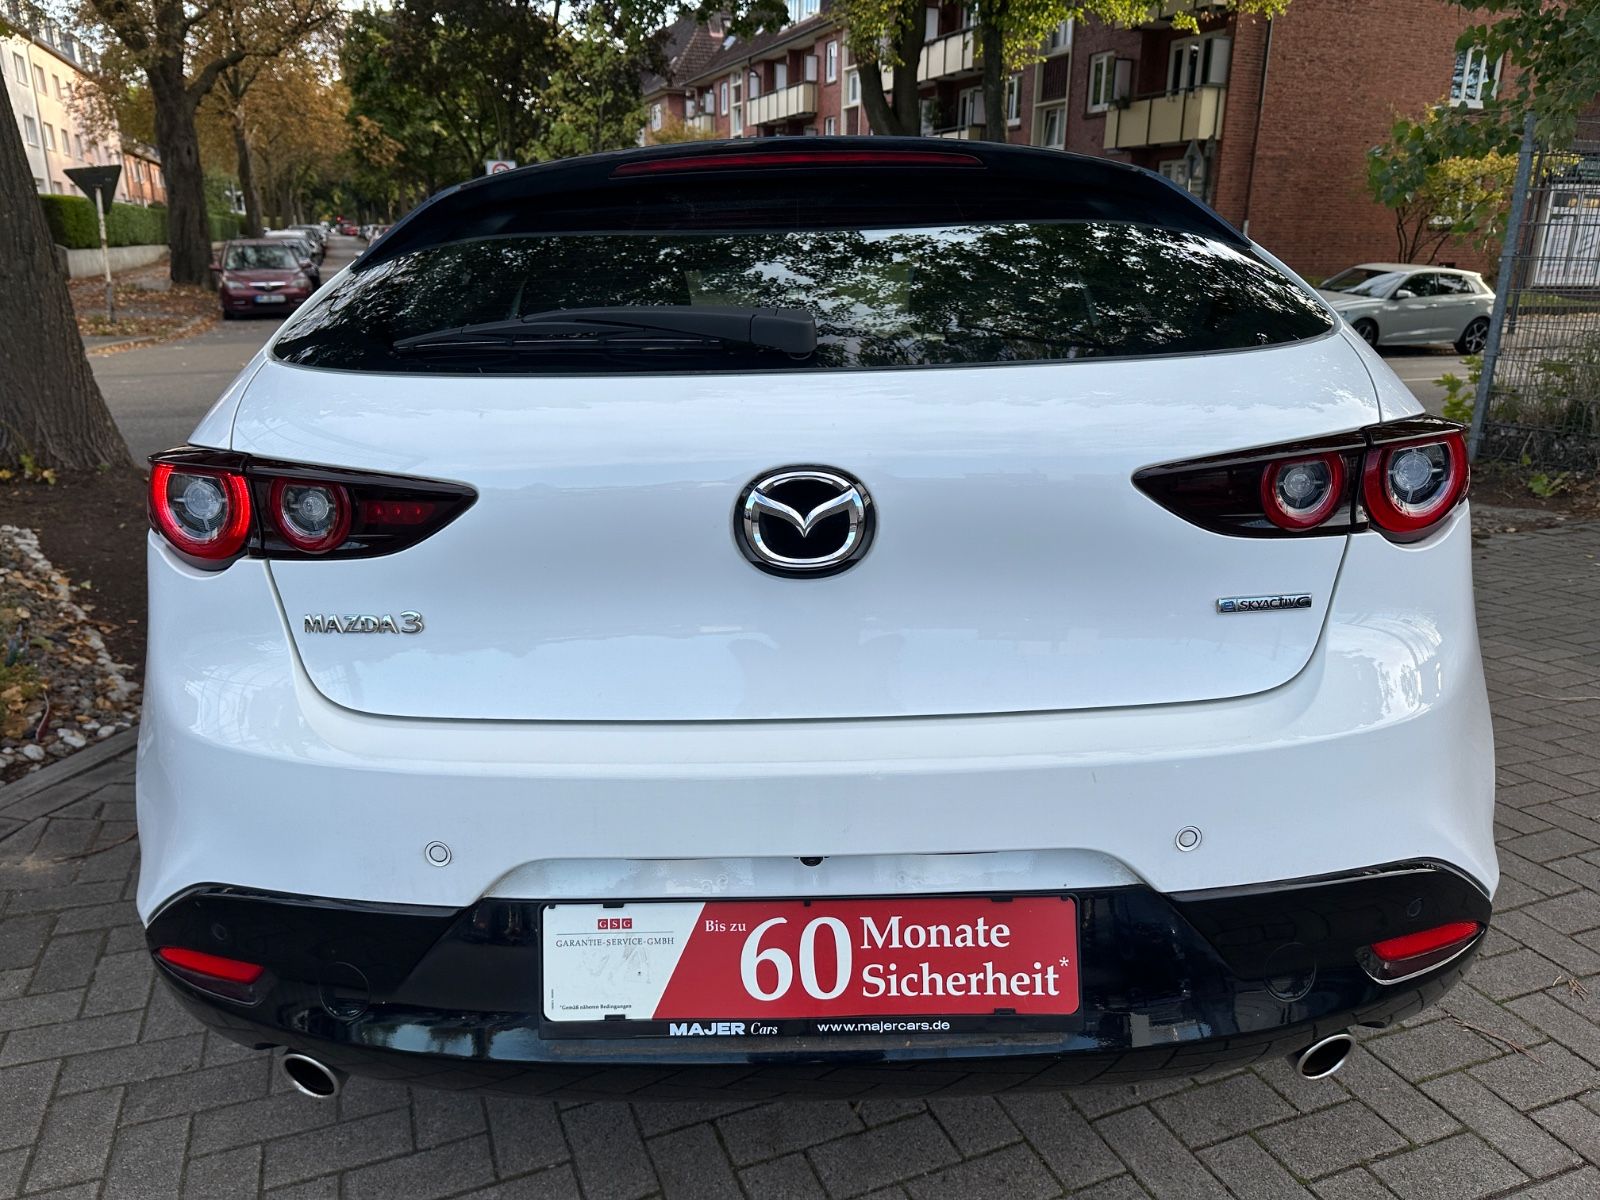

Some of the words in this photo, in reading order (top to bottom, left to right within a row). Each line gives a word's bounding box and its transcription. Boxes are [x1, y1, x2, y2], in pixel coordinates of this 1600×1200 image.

[598, 918, 633, 930] GSG
[705, 919, 726, 933] Bis
[729, 923, 747, 933] zu
[860, 915, 1011, 950] Monate
[555, 937, 675, 948] GARANTIE-SERVICE-GMBH
[740, 916, 852, 1002] 60
[669, 1022, 745, 1036] MAJER
[750, 1021, 778, 1035] Cars
[817, 1020, 950, 1033] www.majercars.de
